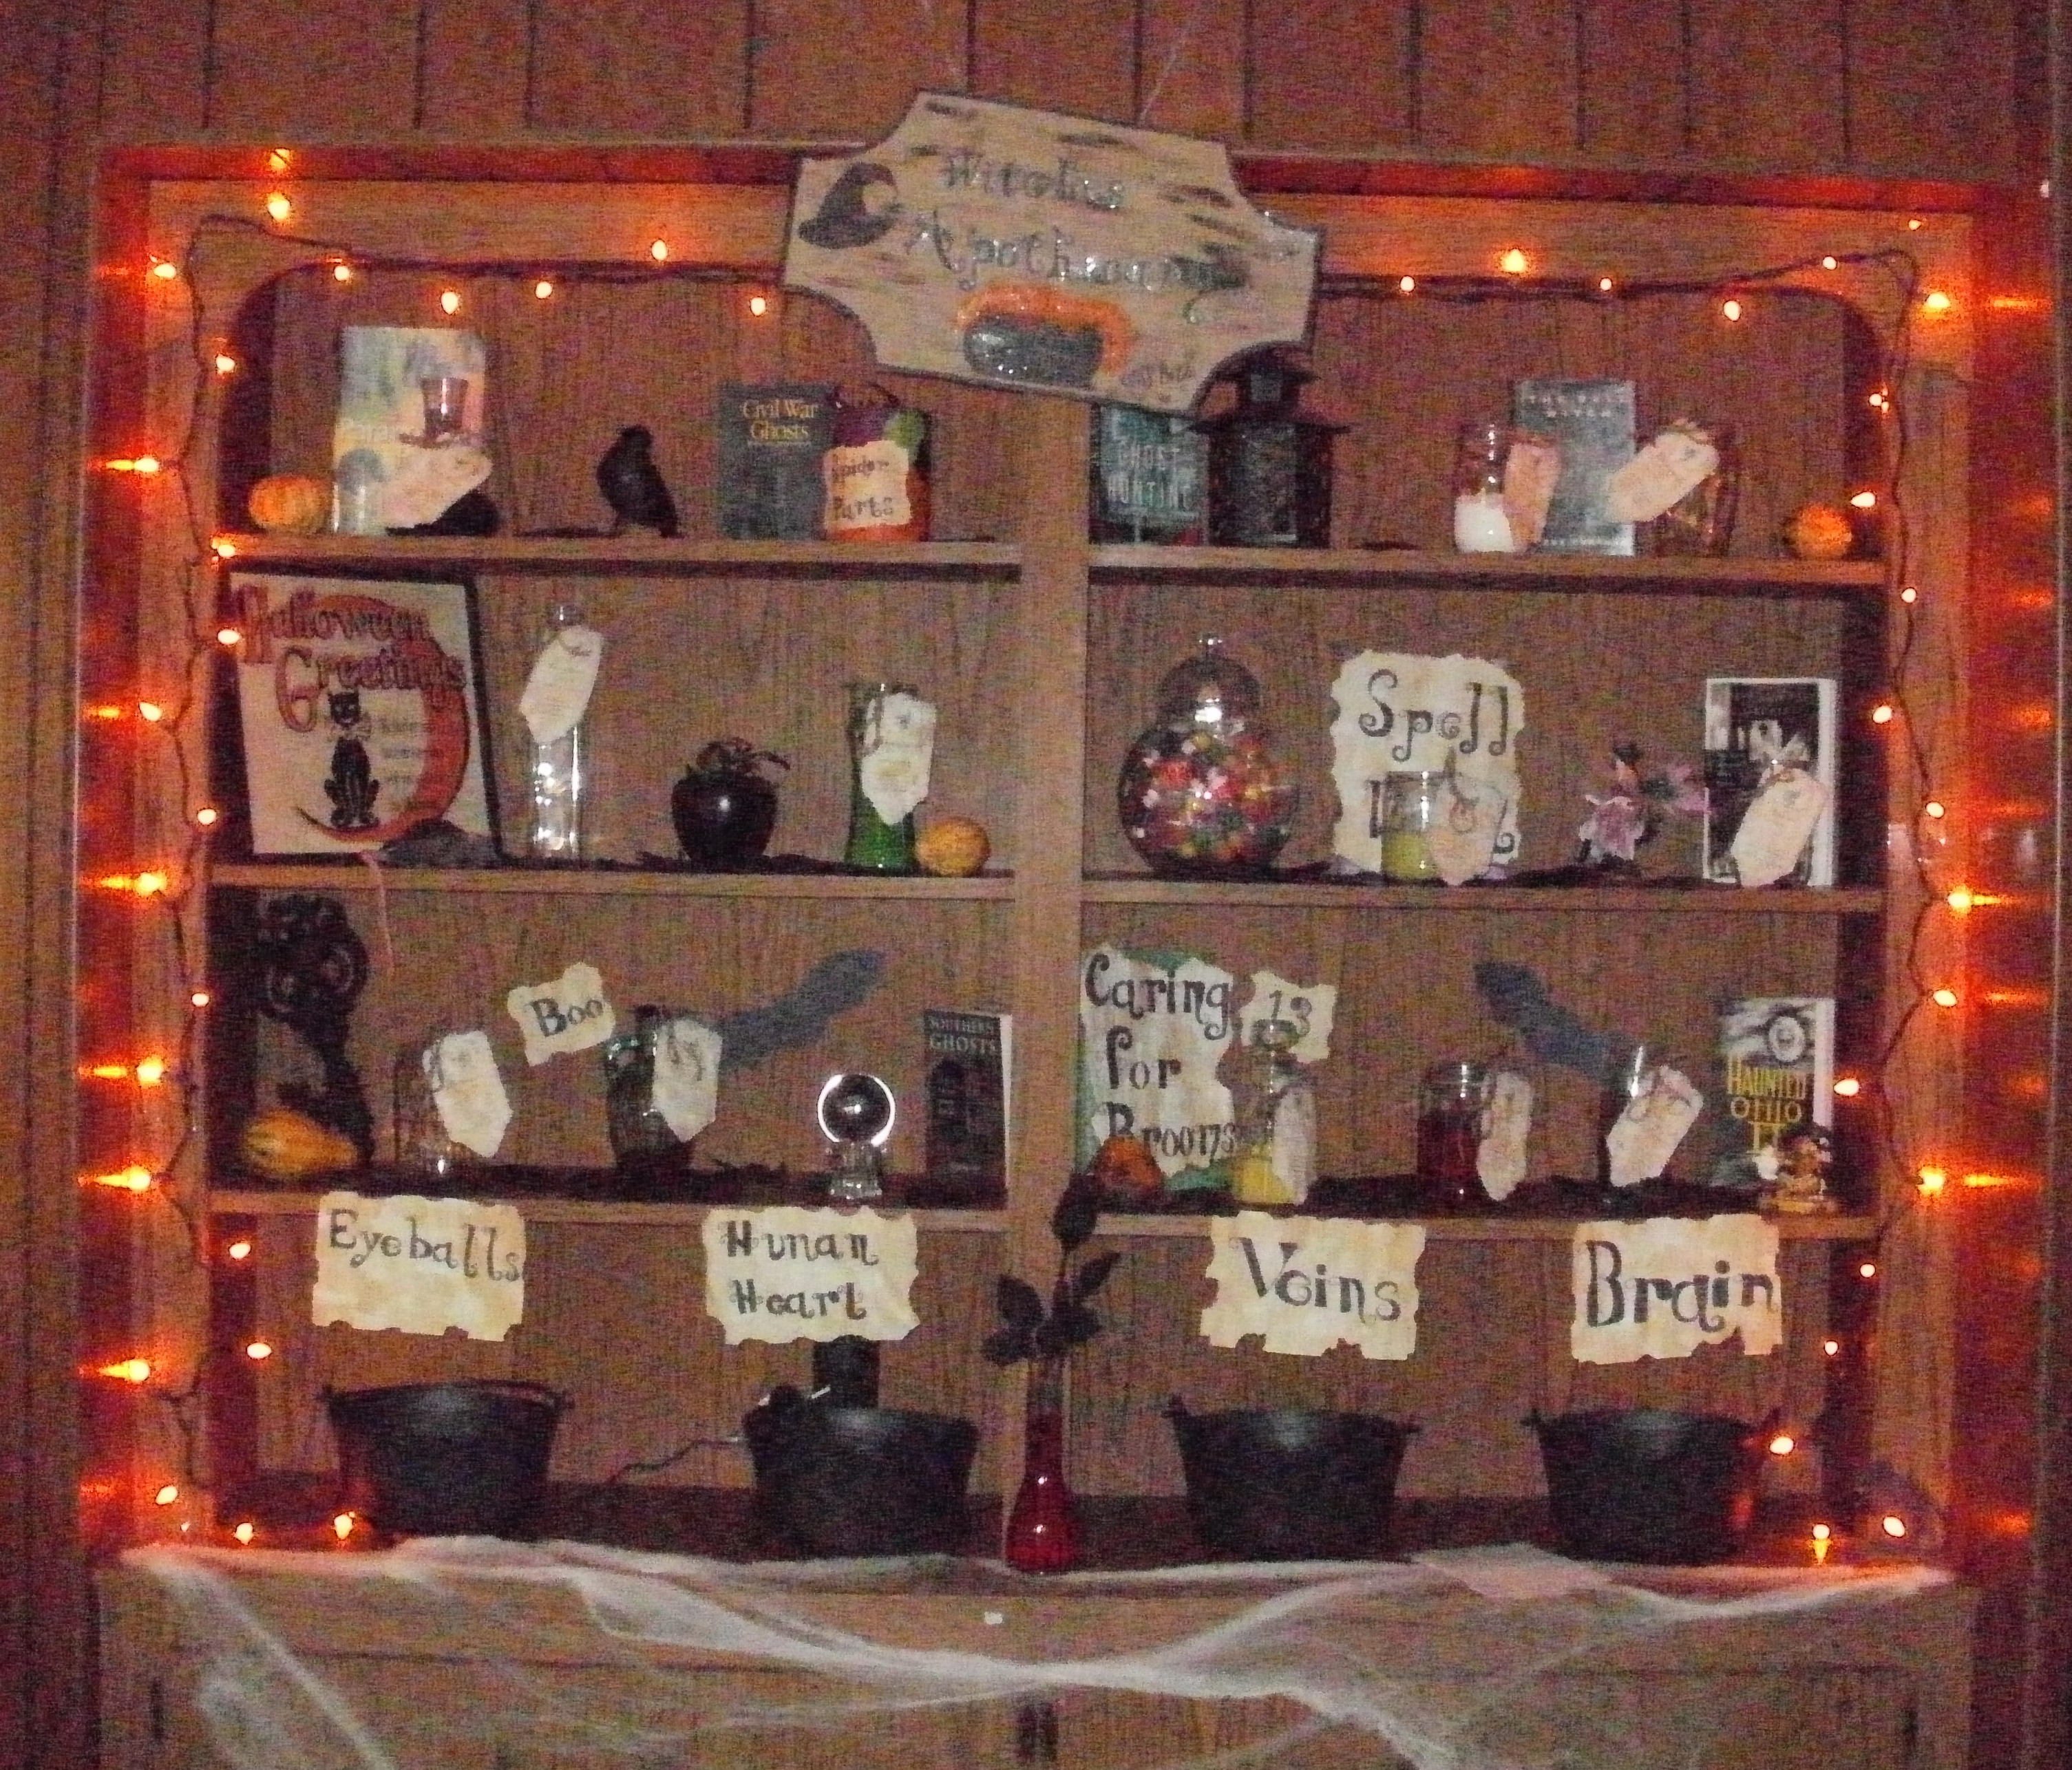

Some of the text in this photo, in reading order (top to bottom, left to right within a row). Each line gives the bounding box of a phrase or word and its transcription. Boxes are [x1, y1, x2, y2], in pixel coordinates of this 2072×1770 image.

[750, 420, 810, 442] Ghosts
[785, 400, 819, 419] War
[1357, 668, 1509, 763] Spell
[528, 997, 603, 1038] Boo
[1085, 953, 1231, 1041] Caring
[330, 1208, 521, 1282] Eyeballs
[1229, 1237, 1402, 1324] Veins
[728, 1278, 867, 1320] Heart
[1583, 1239, 1779, 1332] Brain
